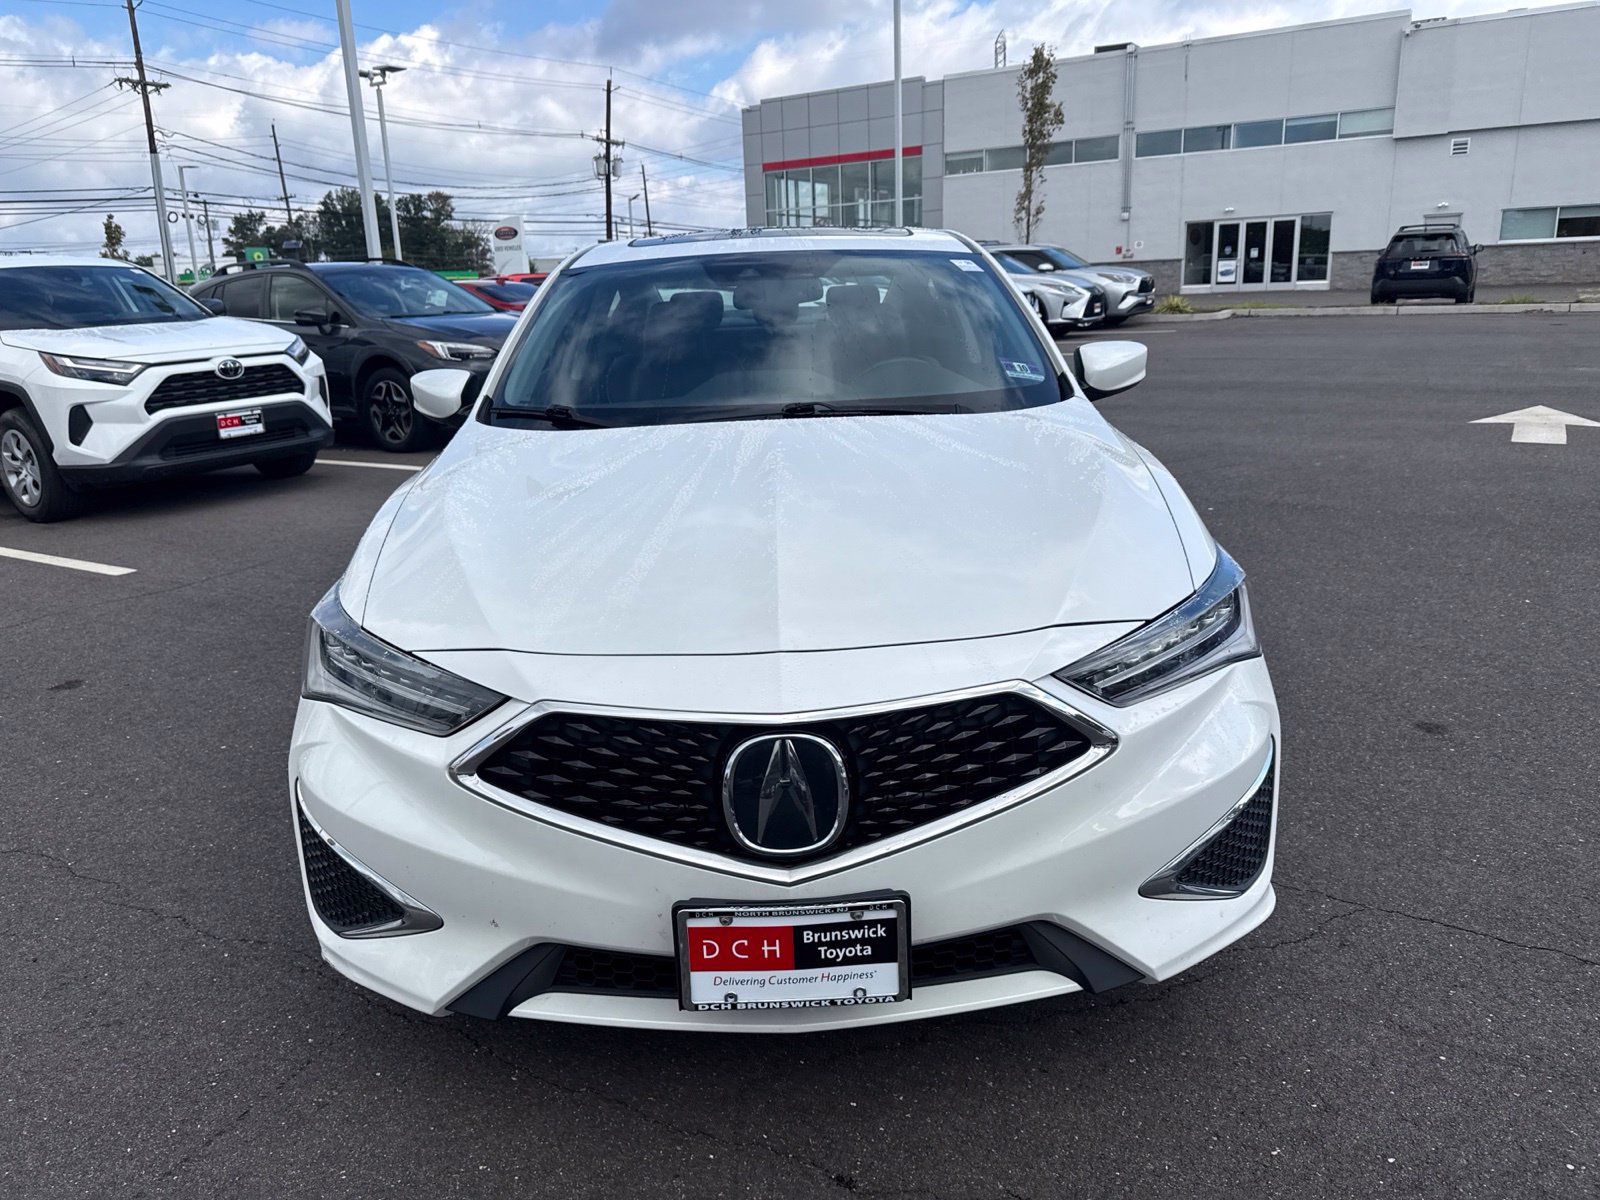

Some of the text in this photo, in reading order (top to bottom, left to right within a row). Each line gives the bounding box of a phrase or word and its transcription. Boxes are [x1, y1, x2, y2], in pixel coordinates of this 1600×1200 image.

[803, 923, 887, 944] Brunswick
[817, 943, 872, 962] Toyota
[713, 976, 766, 988] Delivering
[768, 975, 819, 985] Customer
[697, 995, 896, 1011] DCH BRUNSWICK TOYOTA
